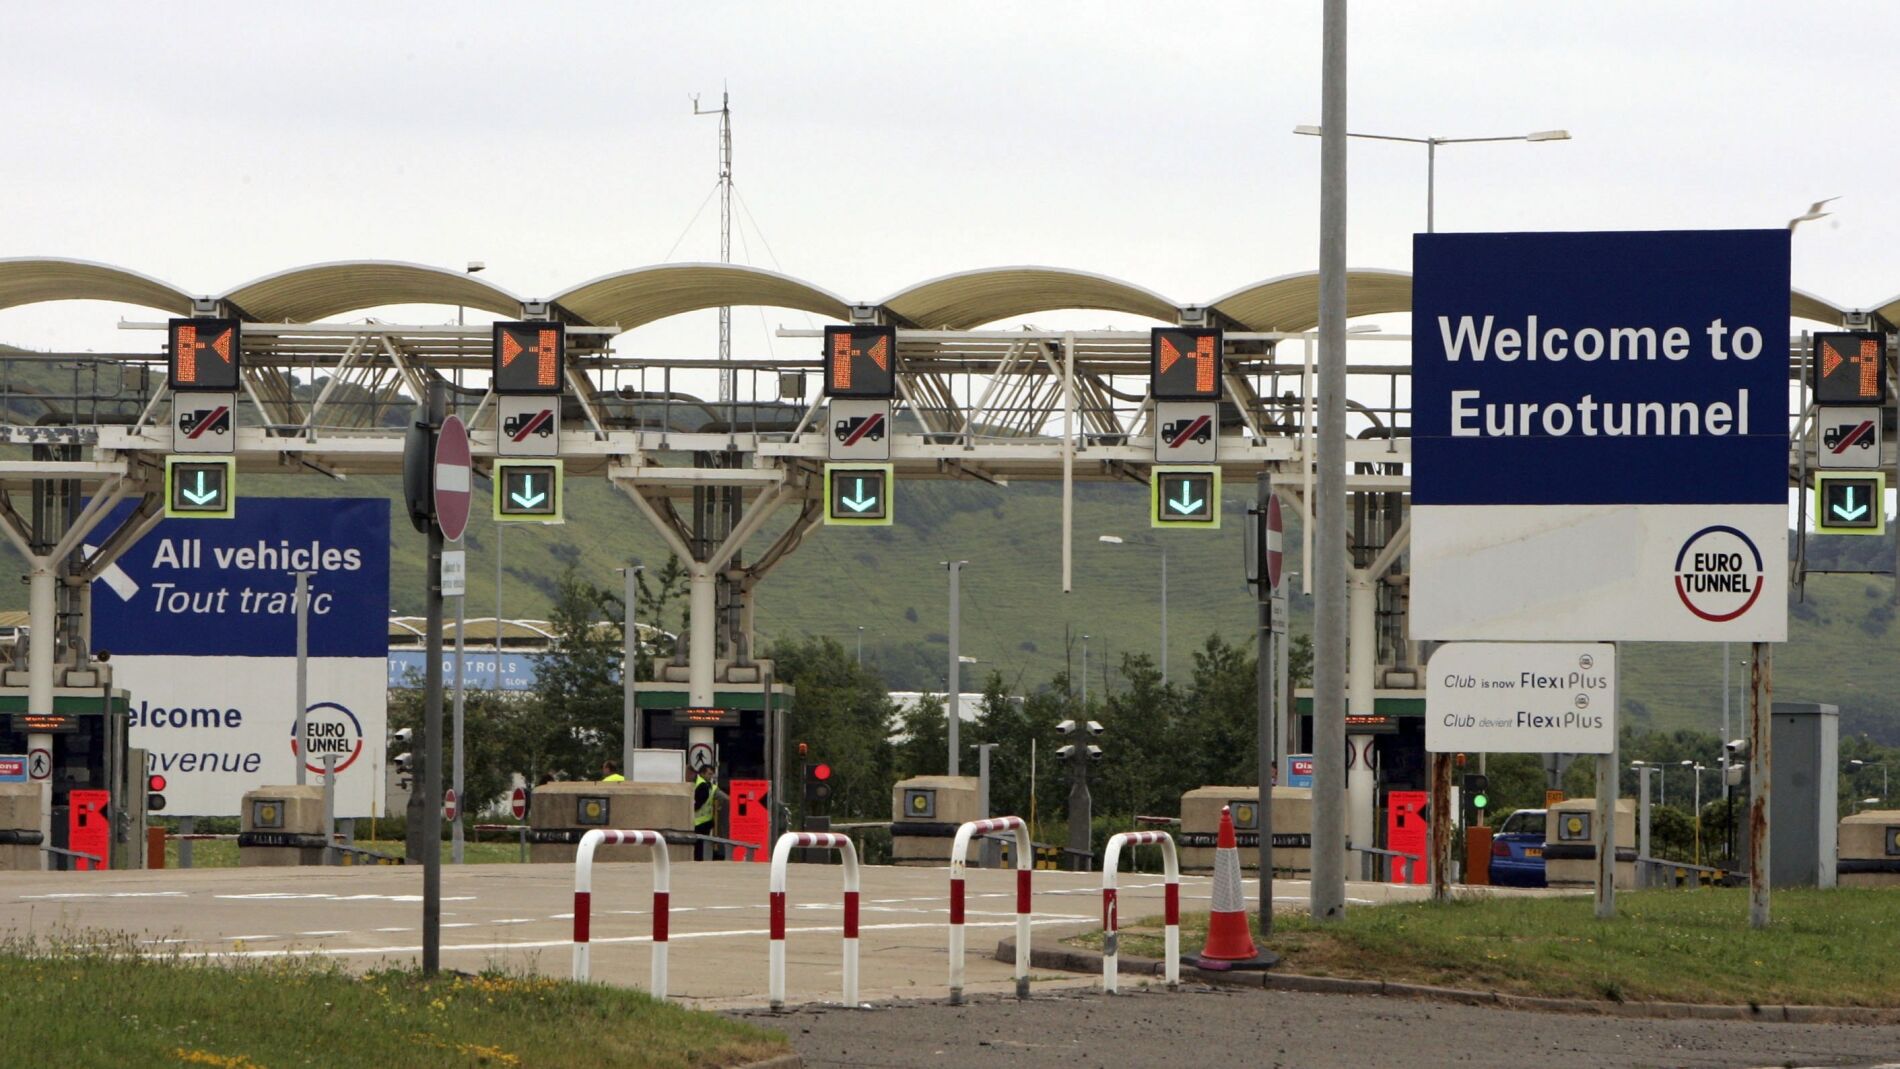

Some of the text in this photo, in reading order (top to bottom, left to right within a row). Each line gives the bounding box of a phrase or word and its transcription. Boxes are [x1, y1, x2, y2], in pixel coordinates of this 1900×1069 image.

[1437, 315, 1763, 362] Welcome to
[1451, 388, 1749, 437] Eurotunnel
[152, 538, 362, 571] All vehicles
[1694, 552, 1743, 573] EURO
[1683, 573, 1752, 593] TUNNEL
[152, 582, 230, 614] Tout
[442, 661, 517, 673] OTROLS
[1444, 674, 1477, 689] Club
[1481, 678, 1490, 689] is
[1492, 679, 1516, 689] now
[128, 700, 243, 729] elcome
[1443, 713, 1476, 728] Club
[307, 722, 346, 738] EURO
[303, 738, 354, 753] UNNEL
[149, 751, 262, 773] nvenue
